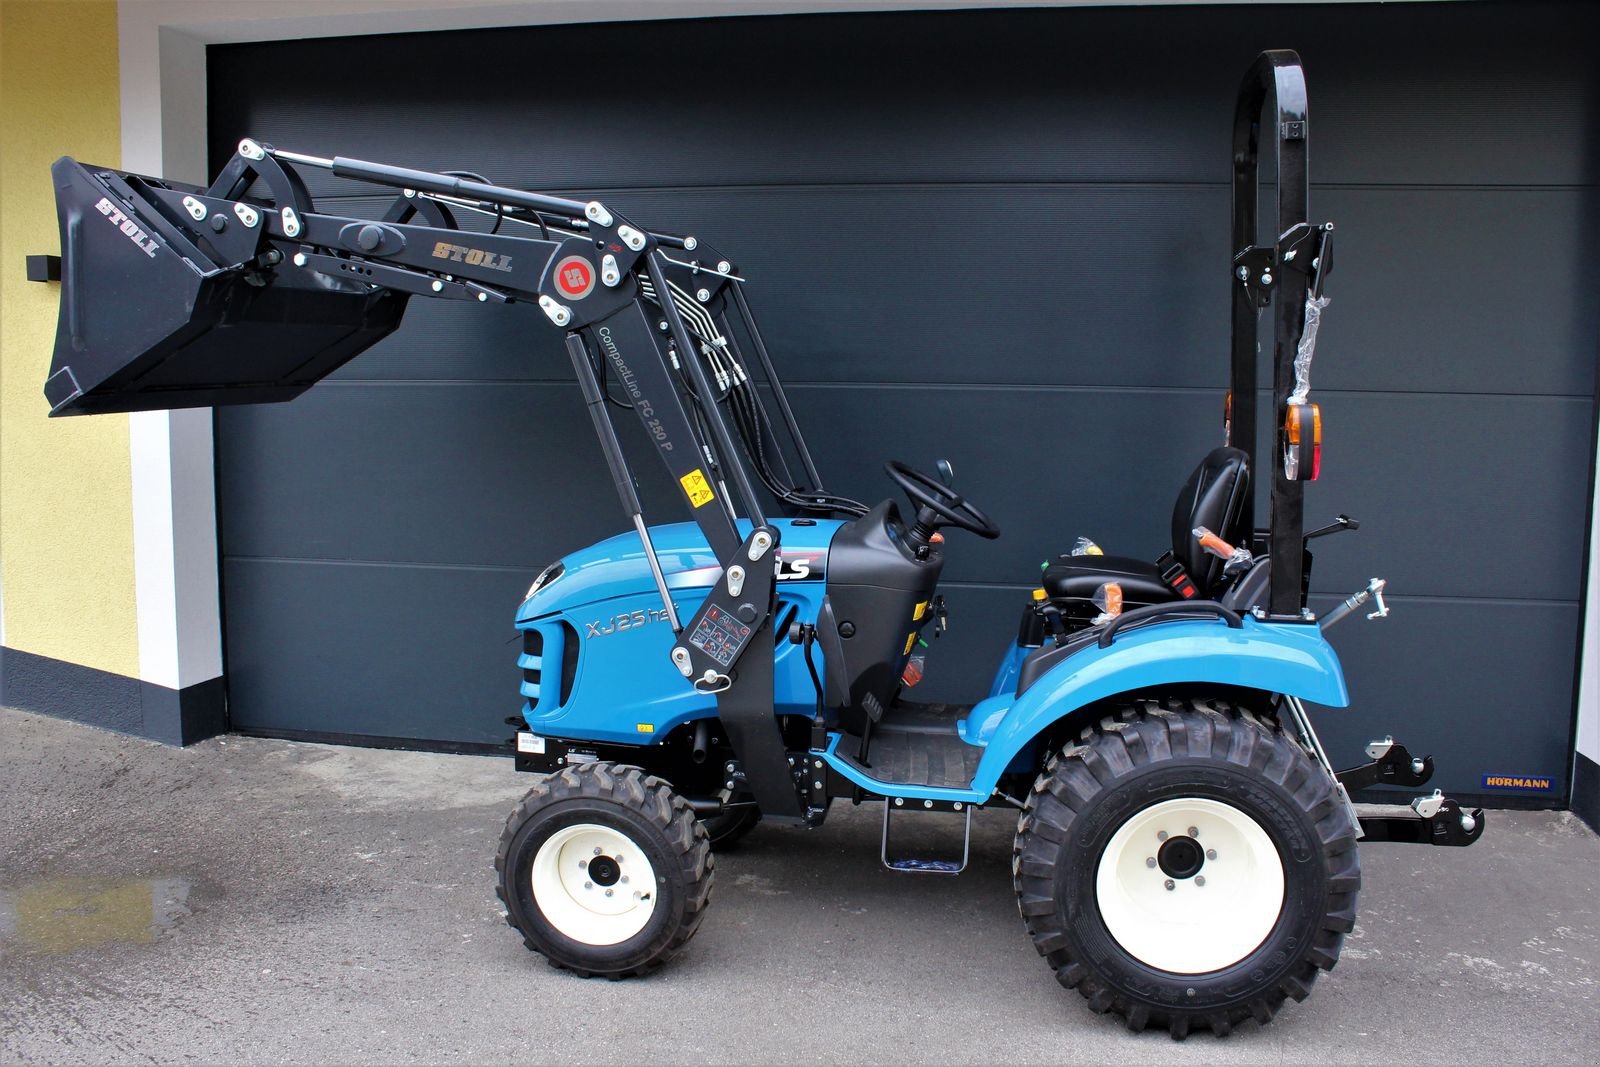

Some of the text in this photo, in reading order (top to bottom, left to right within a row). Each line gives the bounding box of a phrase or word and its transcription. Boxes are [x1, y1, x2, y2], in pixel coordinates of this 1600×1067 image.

[95, 197, 160, 258] STOLL
[432, 242, 513, 273] STOLL
[599, 327, 642, 399] CompactLine
[638, 400, 654, 418] FC
[661, 442, 673, 451] P
[775, 558, 810, 580] LS
[586, 603, 679, 640] XJ25hs
[1486, 776, 1550, 789] HÖRMANN
